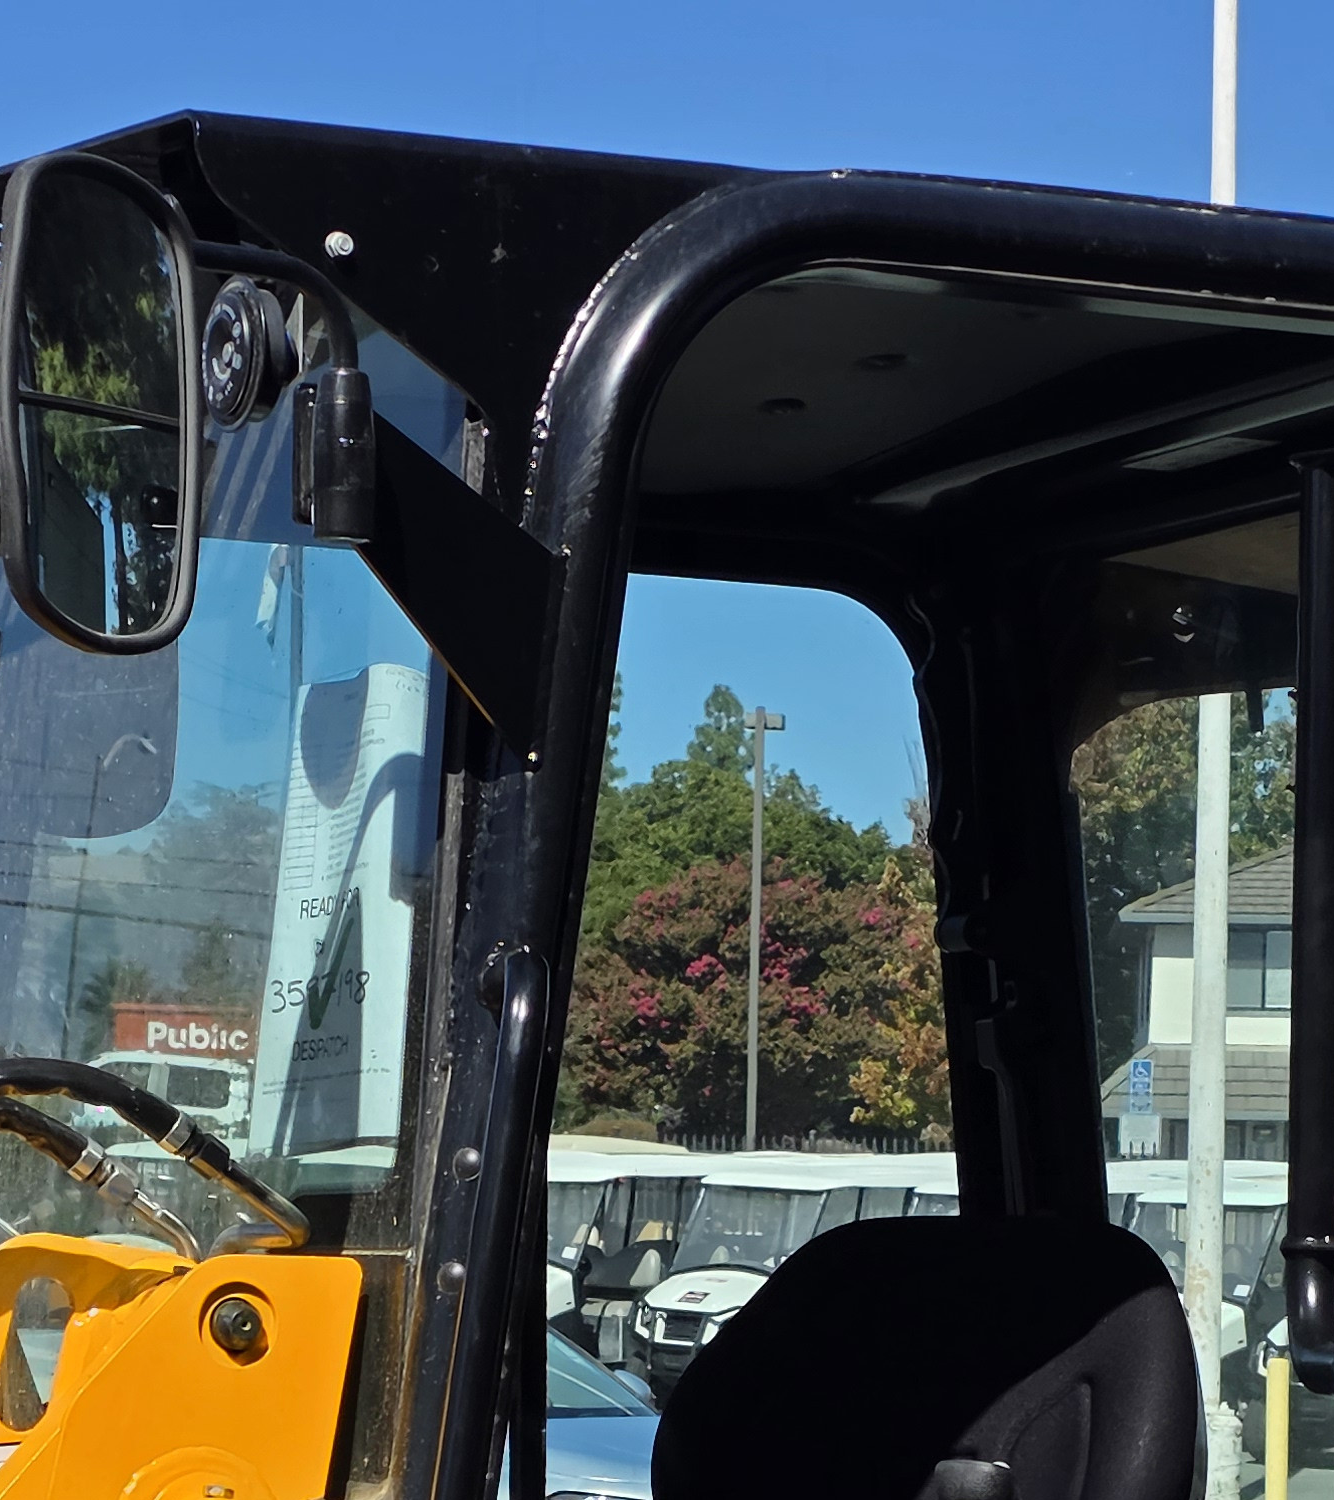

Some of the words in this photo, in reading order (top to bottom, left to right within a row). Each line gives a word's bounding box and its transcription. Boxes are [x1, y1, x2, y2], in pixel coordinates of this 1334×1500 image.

[299, 893, 338, 920] READ
[147, 1021, 249, 1050] Public
[291, 1034, 349, 1062] DESPATCH
